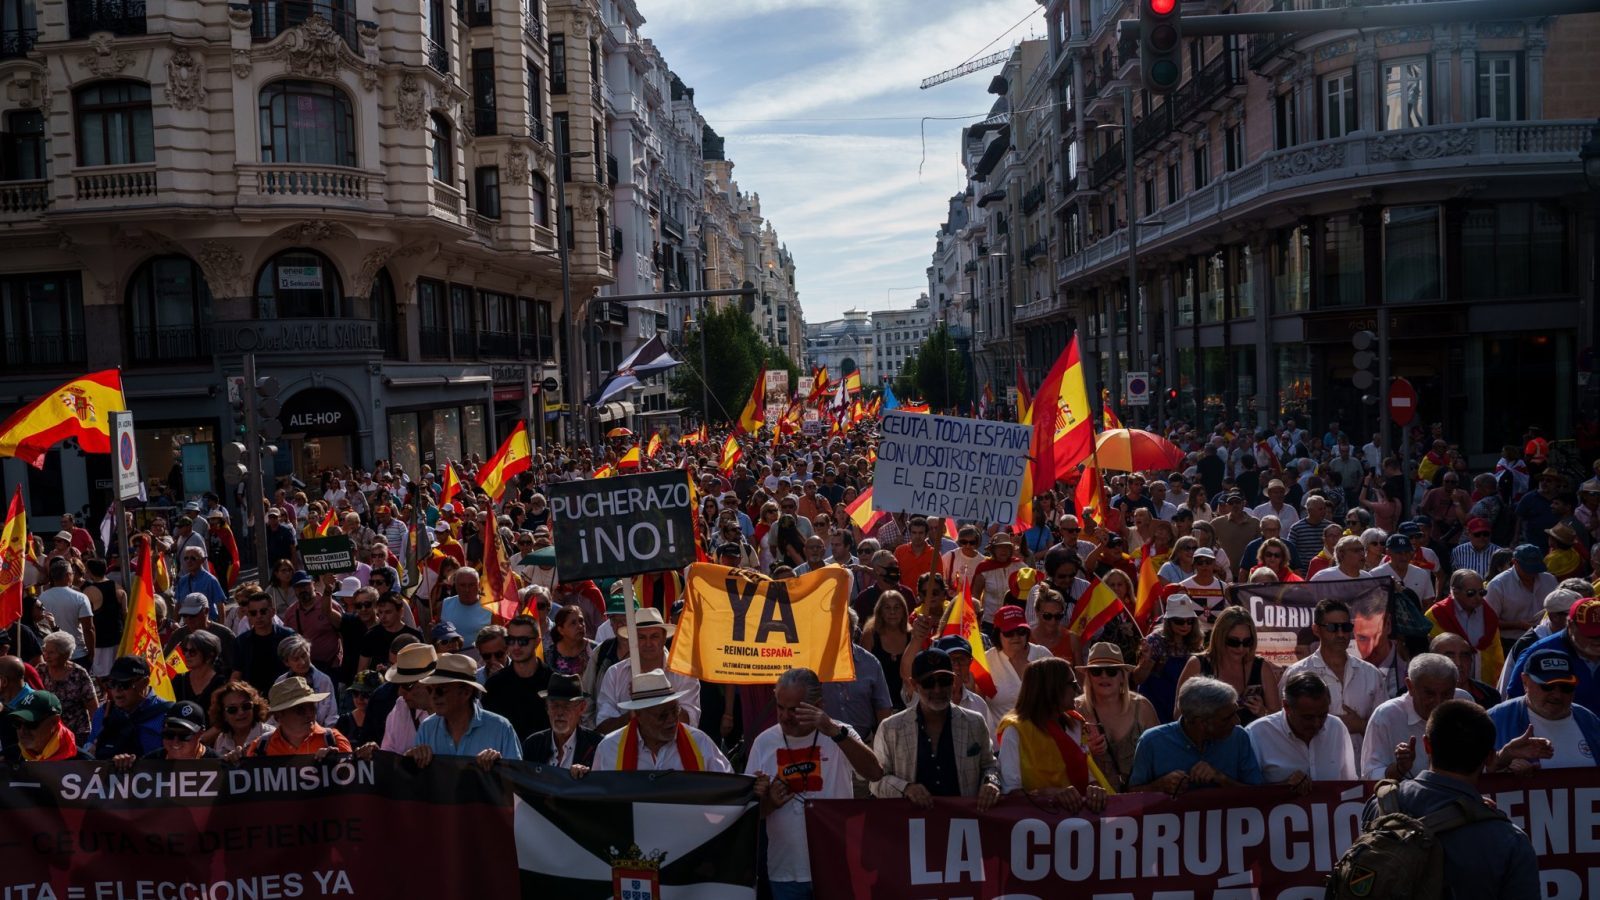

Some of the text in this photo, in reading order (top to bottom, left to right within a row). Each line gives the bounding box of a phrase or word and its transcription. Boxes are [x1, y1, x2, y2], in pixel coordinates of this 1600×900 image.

[281, 322, 334, 349] RAFAEL
[290, 411, 341, 426] ALE-HOP
[934, 418, 971, 444] TODA
[973, 424, 1030, 450] ESPAÑA
[894, 467, 1018, 498] EL GOBIERNO
[551, 483, 690, 521] PUCHERAZO
[911, 490, 1013, 525] MARCIANO
[725, 578, 799, 643] YA
[722, 661, 751, 670] ULTIMÁTUM
[724, 645, 793, 658] REINICIA ESPAÑA
[60, 758, 376, 801] SÁNCHEZ DIMISIÓN
[197, 817, 364, 854] DEFIENDE
[908, 816, 986, 886] LA
[1010, 783, 1367, 882] CORRUPCIÓ
[95, 872, 304, 900] ELECCIONES
[312, 869, 355, 896] YA
